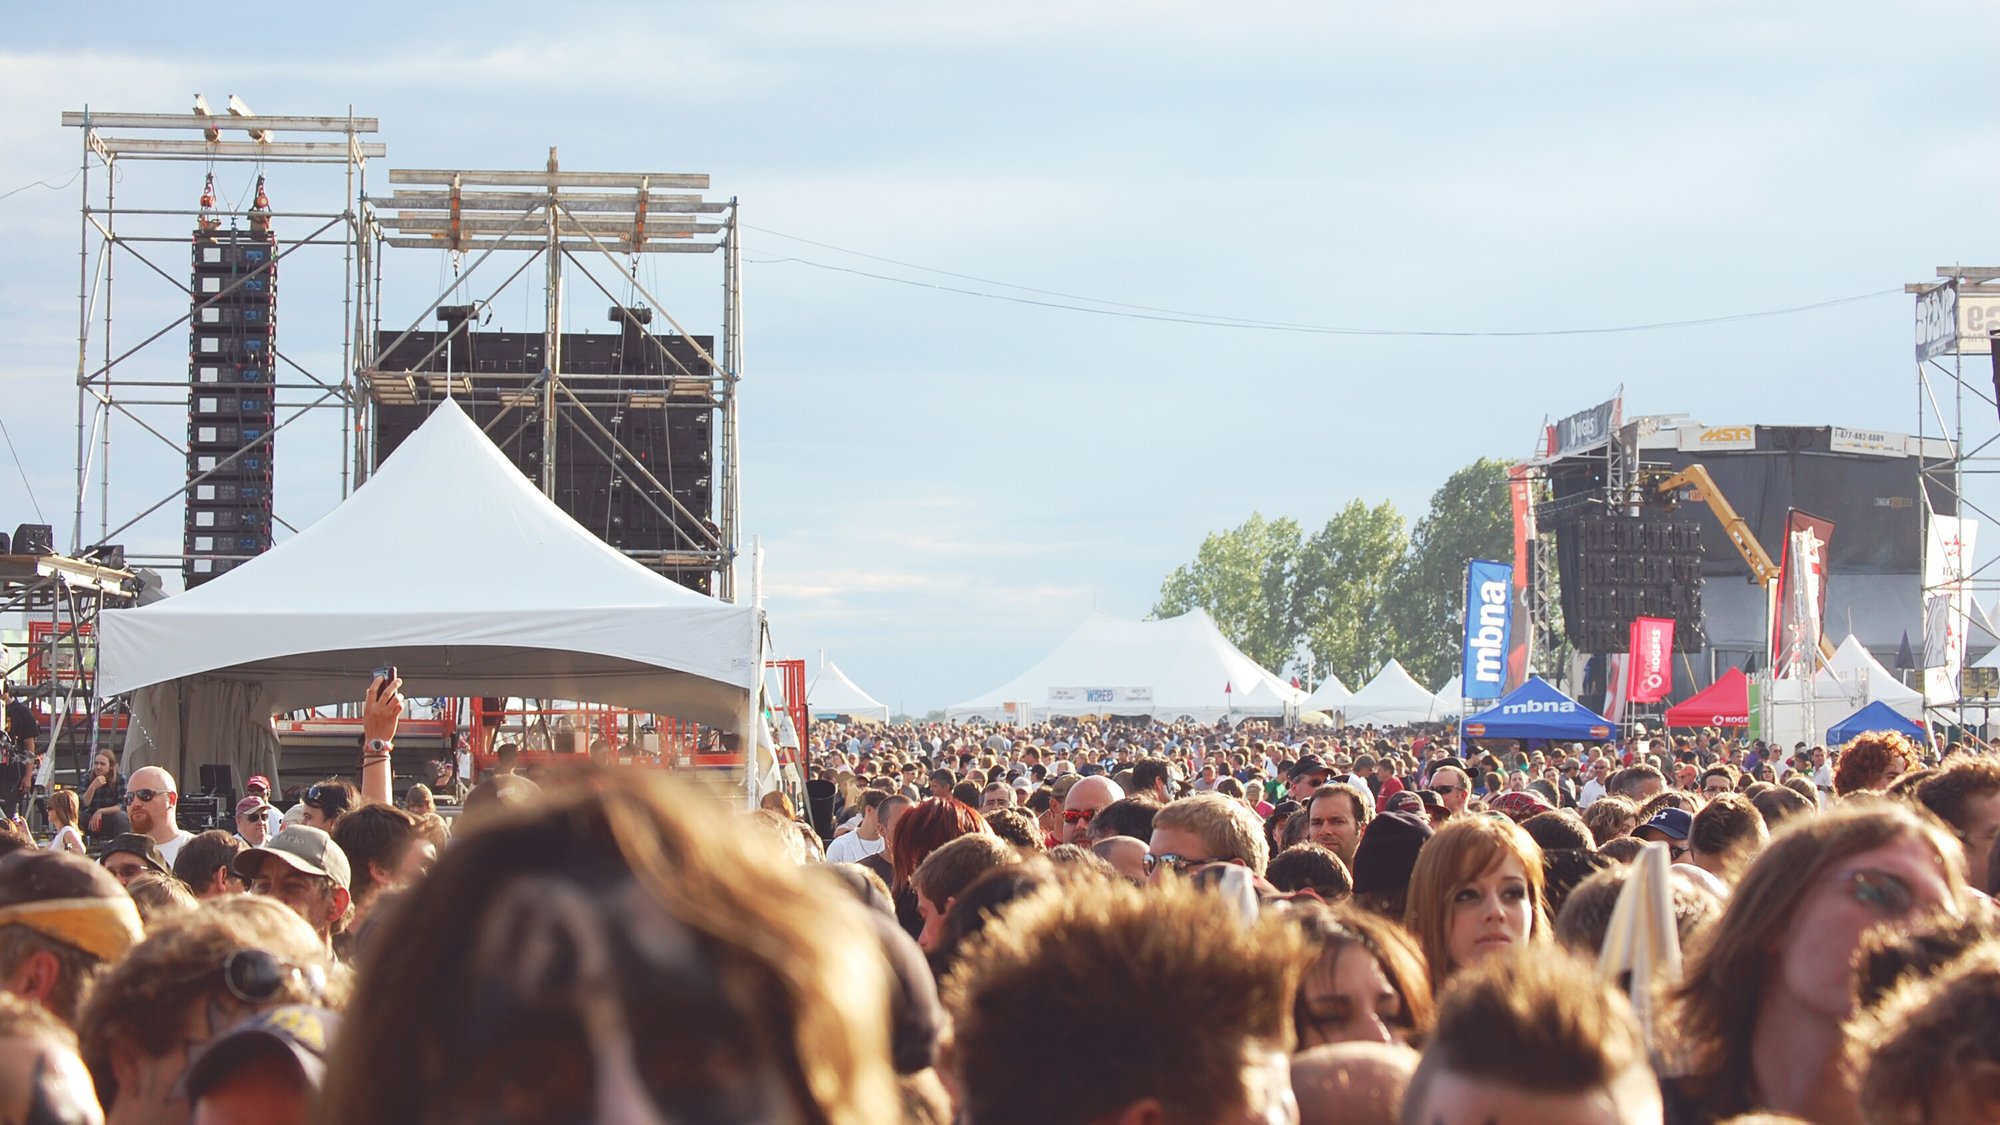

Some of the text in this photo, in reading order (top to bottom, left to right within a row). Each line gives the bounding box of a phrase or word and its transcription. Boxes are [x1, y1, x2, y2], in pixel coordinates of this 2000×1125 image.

[1700, 428, 1752, 442] MSR
[1471, 580, 1506, 682] mbna
[1651, 628, 1661, 673] ROGERS
[1503, 701, 1575, 714] mbna
